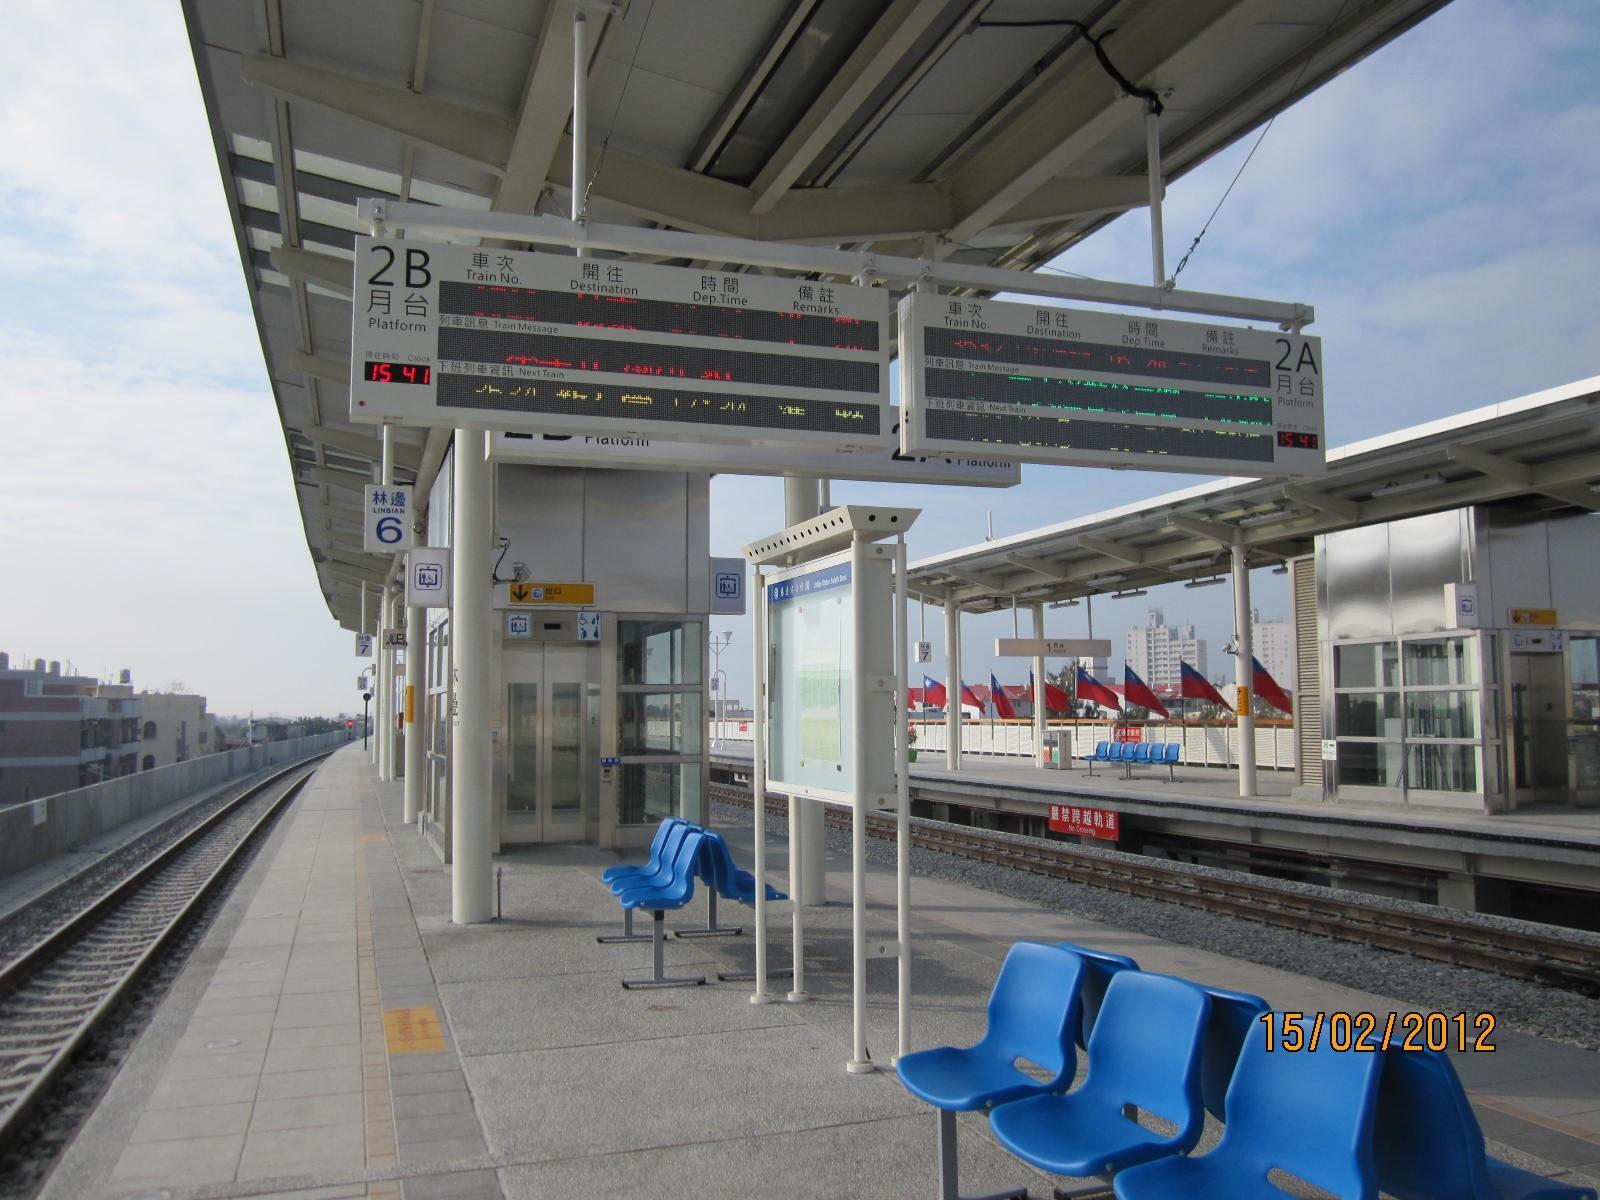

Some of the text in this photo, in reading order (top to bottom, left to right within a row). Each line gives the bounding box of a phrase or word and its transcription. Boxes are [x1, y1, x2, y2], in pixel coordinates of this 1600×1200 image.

[368, 245, 432, 289] 2B
[471, 252, 515, 272] 車次
[466, 269, 523, 285] Train No.
[582, 263, 625, 283] 開往
[570, 279, 638, 296] Destination
[701, 275, 739, 294] 時間
[799, 284, 835, 304] 備註
[367, 289, 430, 318] 月台
[793, 301, 840, 315] Remarks
[948, 301, 983, 319] 車次
[368, 317, 427, 332] Platform
[440, 315, 488, 329] 列車訊息
[494, 320, 558, 334] Train Message
[944, 316, 990, 330] Train No.
[1036, 310, 1069, 328] 開往
[1026, 325, 1081, 339] Destination
[1128, 320, 1158, 337] 時間
[1206, 329, 1235, 346] 備註
[1201, 343, 1240, 356] Remarks
[1275, 338, 1319, 375] 2A
[372, 363, 430, 385] 15 41
[519, 367, 565, 379] Next Train
[968, 361, 1020, 374] Train Message
[1276, 374, 1315, 397] 月台
[989, 404, 1007, 412] Next
[1277, 395, 1315, 409] Platform
[372, 490, 406, 507] 林邊
[373, 507, 405, 515] LINBIAN
[376, 517, 403, 544] 6
[360, 644, 369, 655] 7
[921, 651, 929, 661] 7
